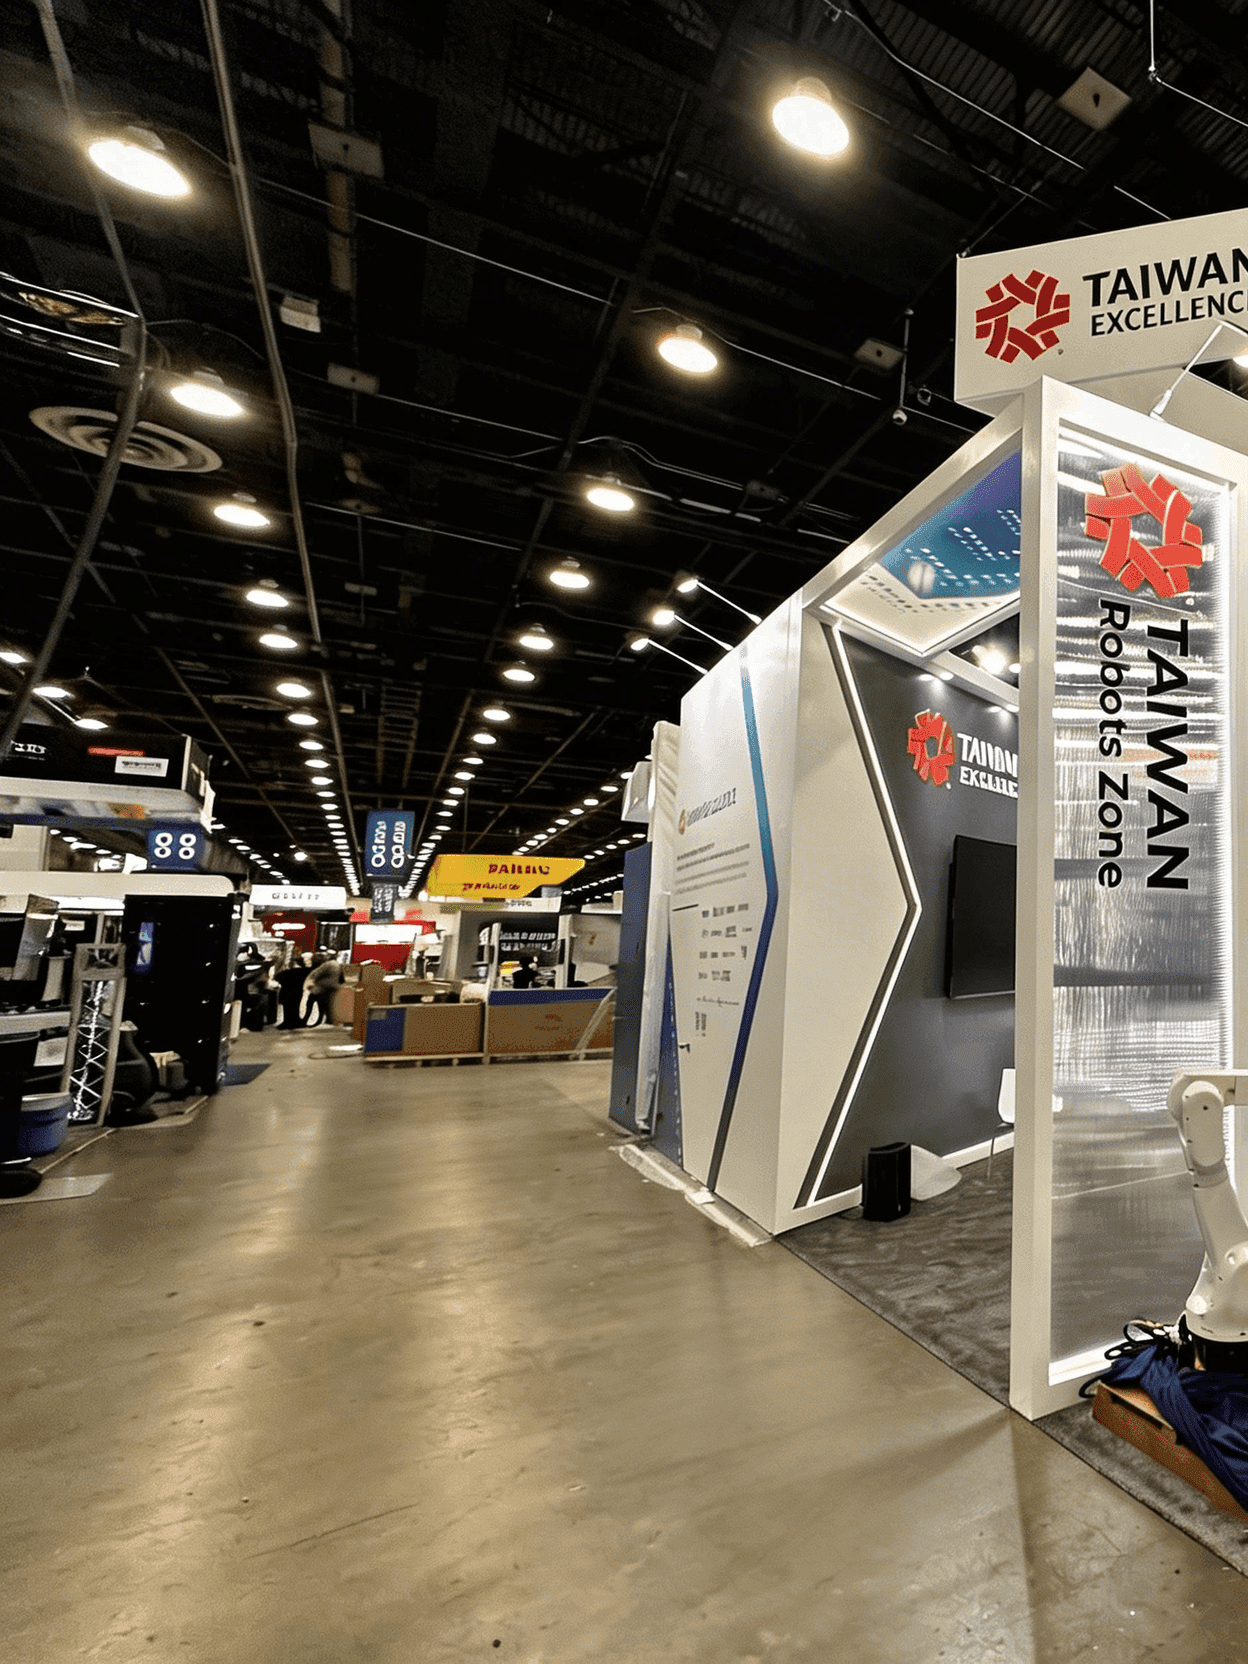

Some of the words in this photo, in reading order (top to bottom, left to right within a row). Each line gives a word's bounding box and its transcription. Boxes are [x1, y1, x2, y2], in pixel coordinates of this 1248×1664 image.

[1099, 598, 1131, 758] Robots
[1146, 618, 1190, 890] TAIWAN
[1097, 769, 1130, 889] Zone
